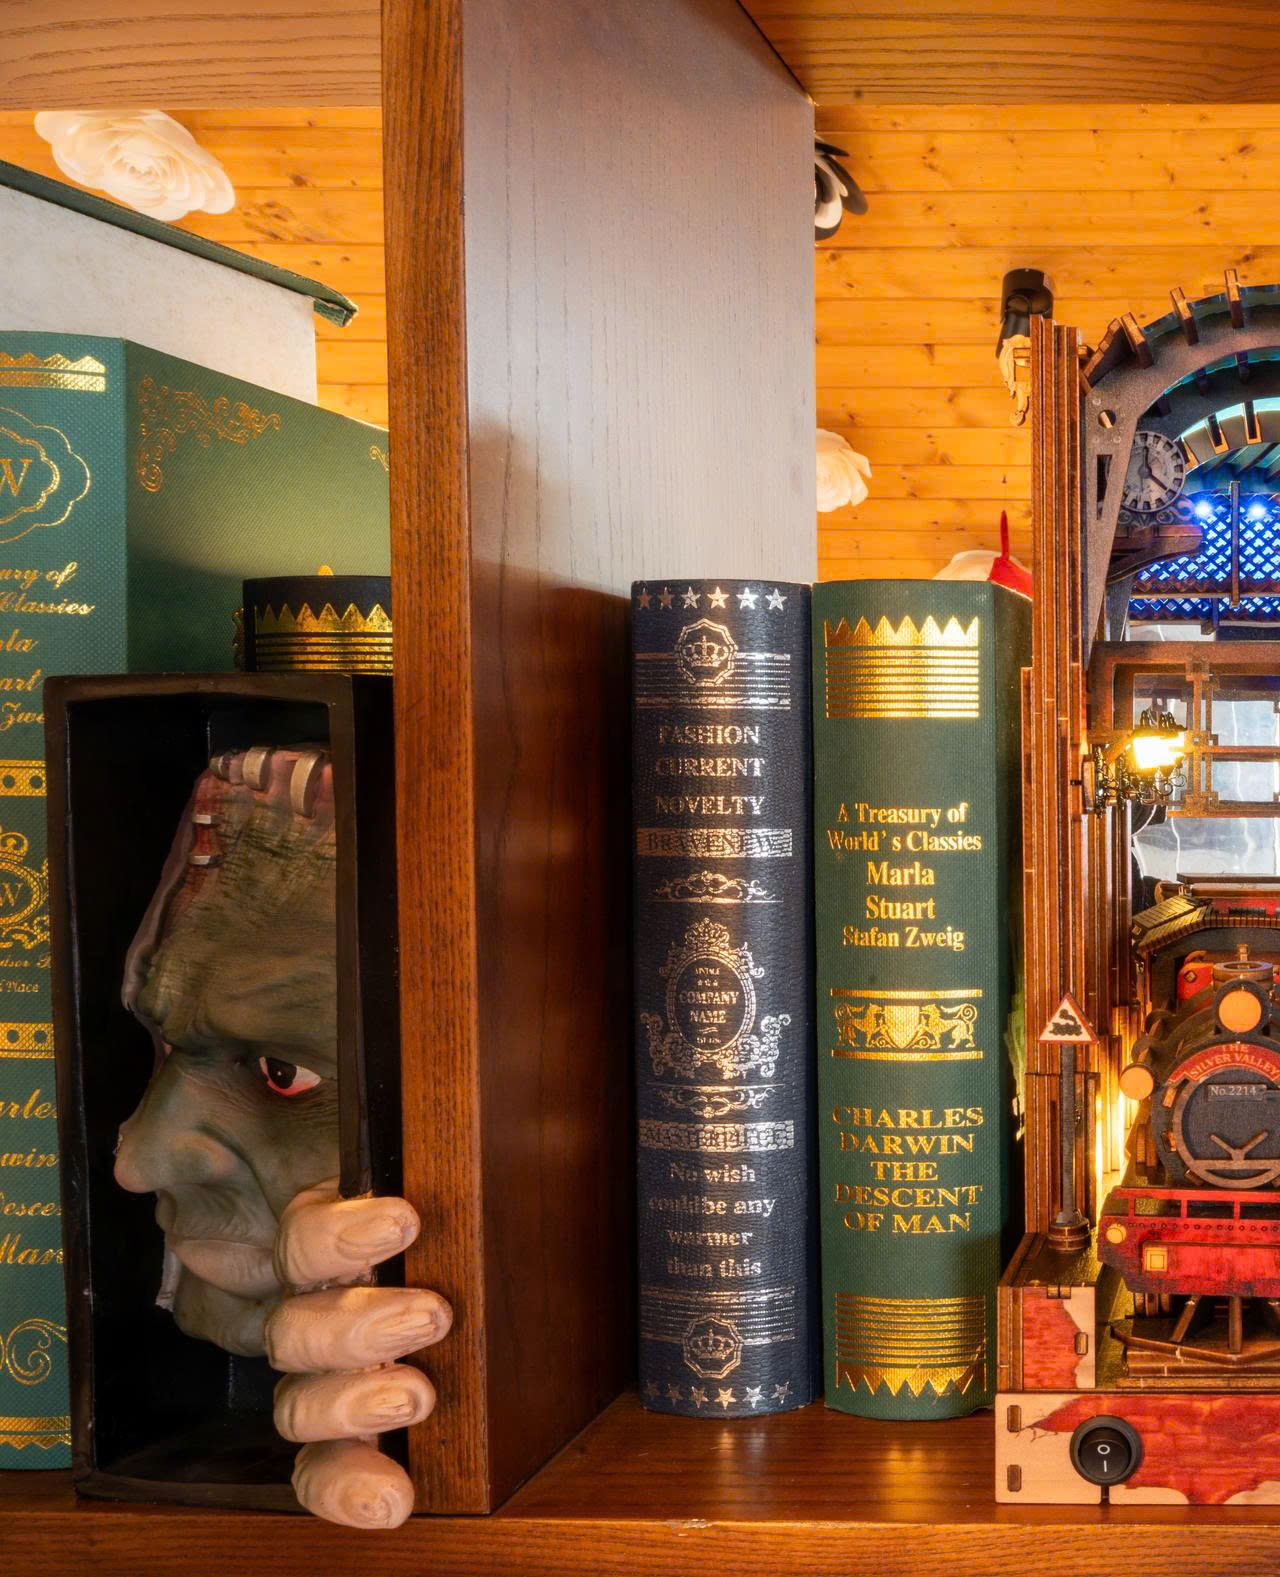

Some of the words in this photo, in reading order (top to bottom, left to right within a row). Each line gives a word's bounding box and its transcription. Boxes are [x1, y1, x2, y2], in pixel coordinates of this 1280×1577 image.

[46, 561, 78, 590] of
[658, 725, 760, 745] FASHION
[656, 757, 766, 777] CURRENT
[656, 795, 766, 815] NOVELTY
[837, 803, 849, 823] A
[855, 802, 942, 828] Treasury
[947, 802, 968, 823] of
[906, 830, 982, 851] Classies
[867, 861, 935, 885] Marla
[866, 895, 936, 919] Stuart
[843, 926, 899, 946] Stafan
[905, 926, 965, 951] Zweig
[680, 990, 740, 1005] COMPANY
[690, 1010, 727, 1024] NAME
[1222, 1044, 1248, 1053] THE
[1190, 1053, 1231, 1077] SILVER
[1235, 1053, 1280, 1077] VALLEY
[832, 1106, 984, 1129] CHARLES
[840, 1132, 976, 1155] DARWIN
[703, 1164, 757, 1183] wish
[870, 1161, 938, 1181] THE
[834, 1184, 984, 1208] DESCENT
[701, 1197, 728, 1215] be
[733, 1199, 776, 1217] any
[844, 1211, 884, 1232] OF
[892, 1213, 971, 1234] MAN
[668, 1232, 753, 1246] warmer
[667, 1257, 713, 1277] than
[719, 1258, 761, 1278] this
